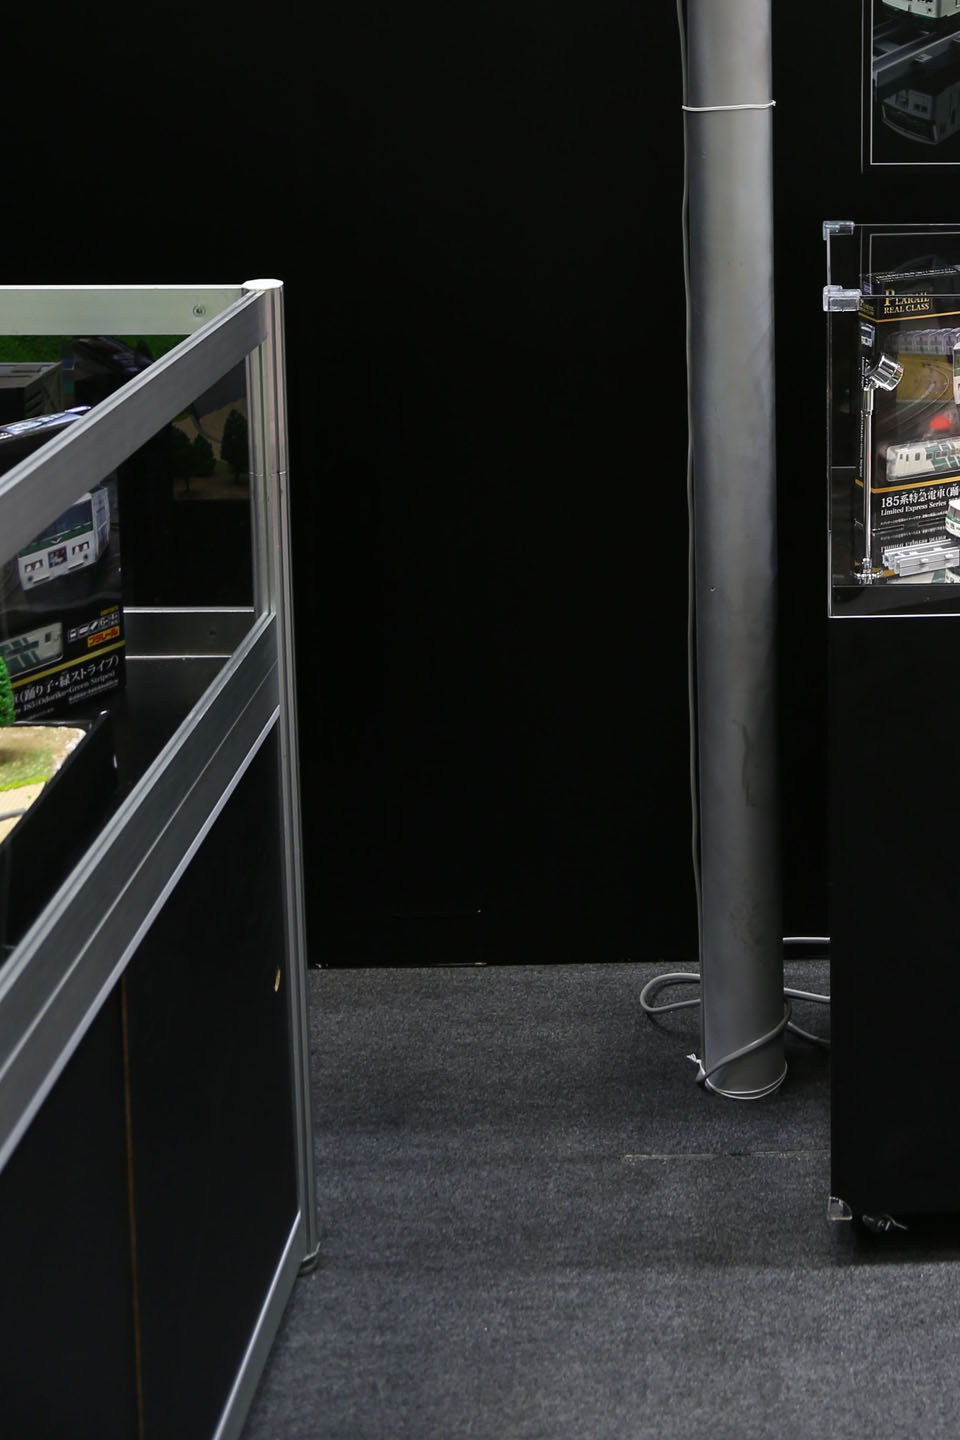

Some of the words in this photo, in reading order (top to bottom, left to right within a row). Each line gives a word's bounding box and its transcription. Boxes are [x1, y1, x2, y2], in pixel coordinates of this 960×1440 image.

[906, 304, 930, 313] CLASS
[881, 506, 904, 516] Limited
[905, 503, 928, 514] Express
[929, 500, 946, 509] Series
